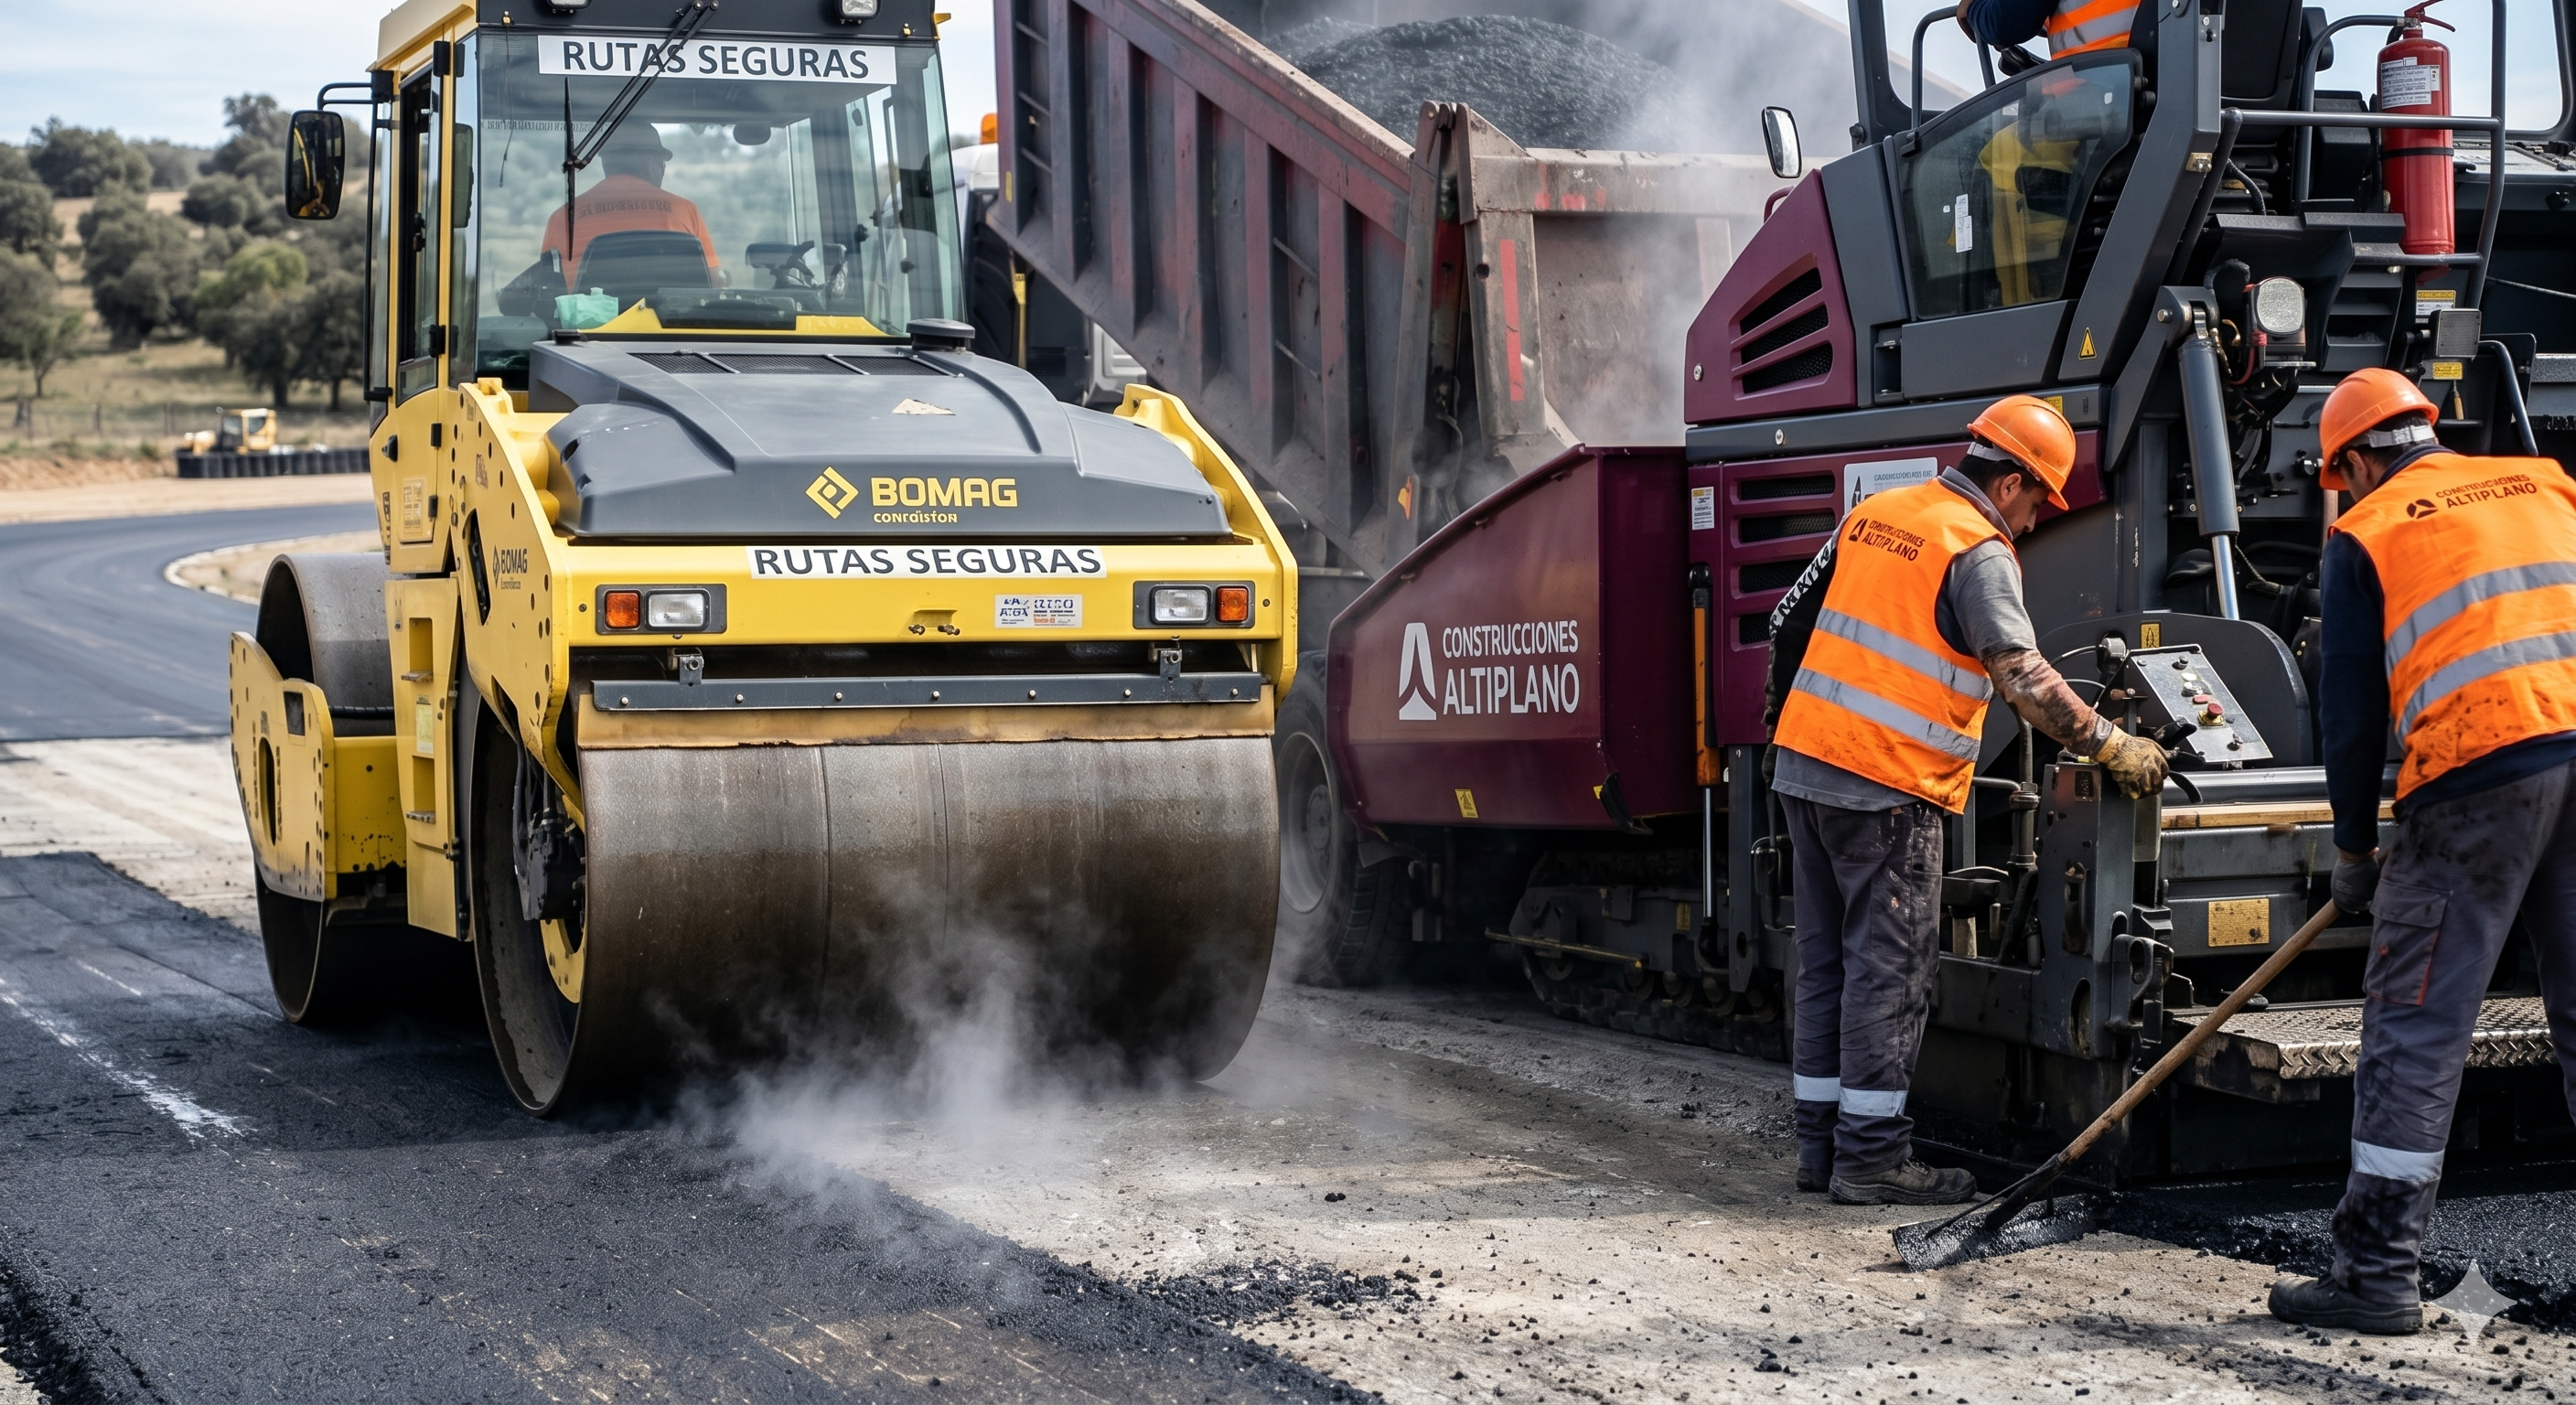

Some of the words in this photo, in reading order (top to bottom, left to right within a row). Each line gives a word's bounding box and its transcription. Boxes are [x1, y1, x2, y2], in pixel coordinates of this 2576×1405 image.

[563, 40, 687, 73] RUTAS
[698, 45, 869, 79] SEGURAS
[871, 477, 1018, 508] BOMAG
[2446, 482, 2538, 509] ALTIPLANO
[500, 548, 528, 574] BOMAG
[754, 549, 895, 574] RUTAS
[906, 548, 1100, 574] SEGURAS
[1443, 619, 1579, 659] CONSTRUCCIONES
[1443, 662, 1580, 715] ALTIPLANO
